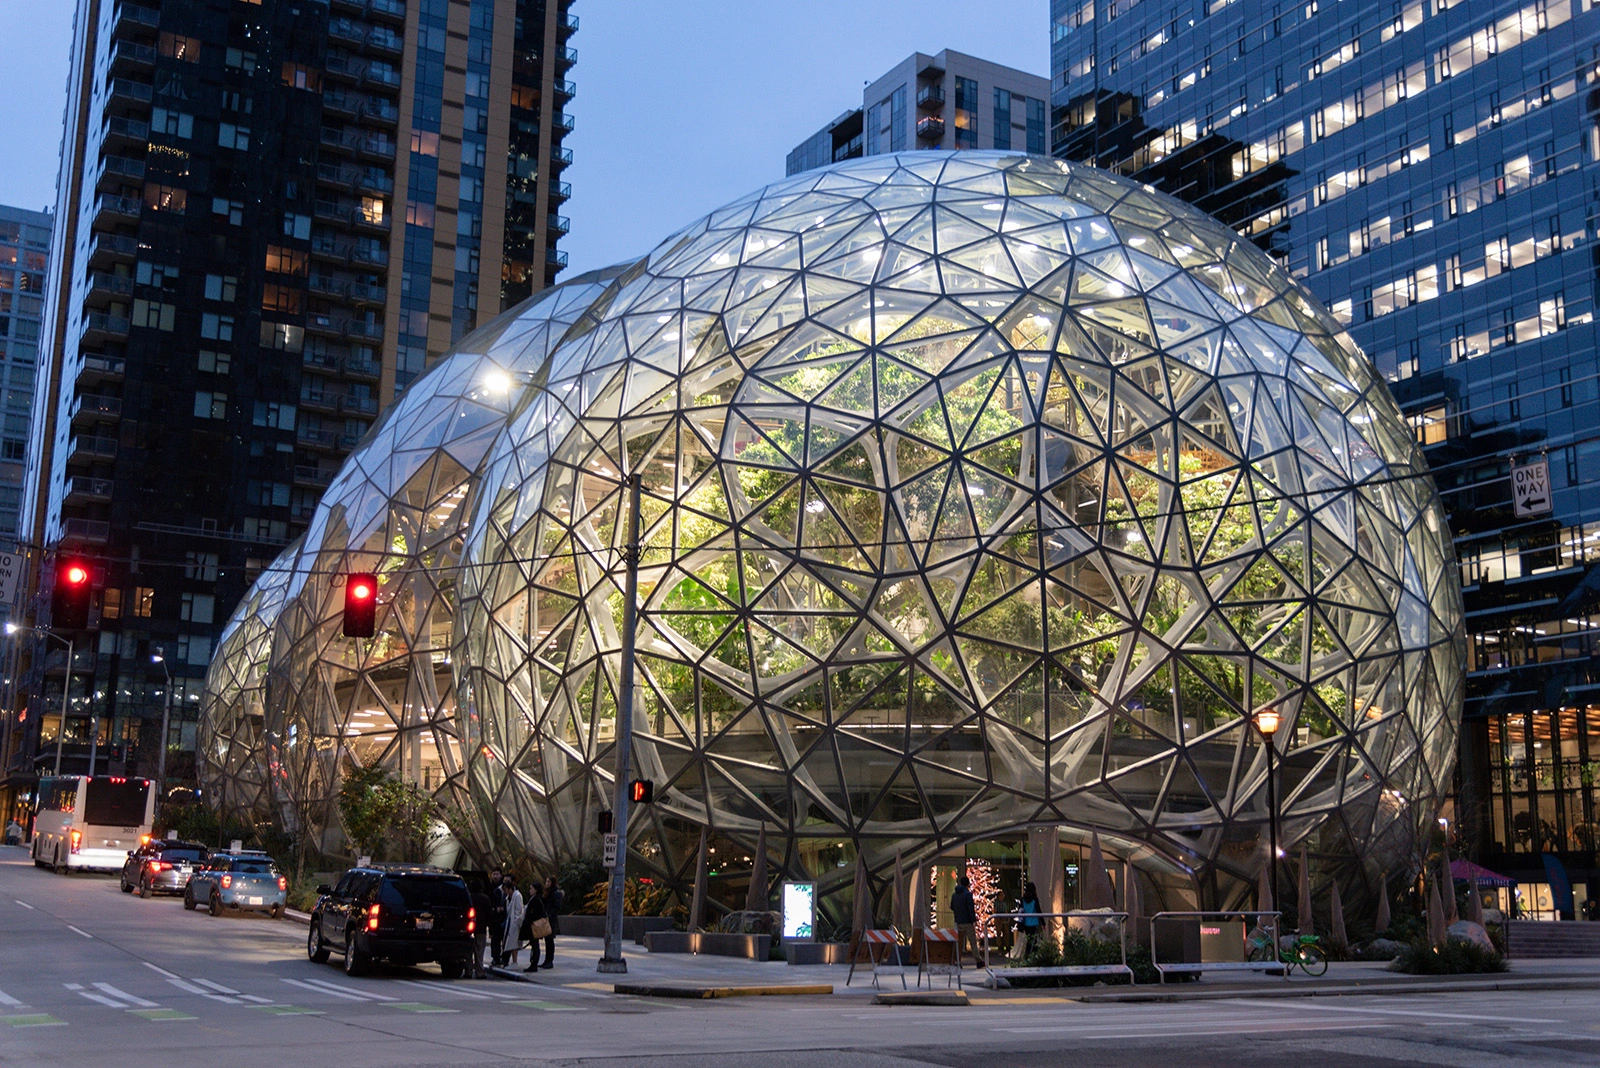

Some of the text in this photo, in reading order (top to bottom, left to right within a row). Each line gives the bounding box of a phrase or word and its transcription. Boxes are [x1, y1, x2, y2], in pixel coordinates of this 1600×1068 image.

[1516, 466, 1543, 483] ONE
[1517, 480, 1545, 497] WAY
[0, 568, 12, 578] RN
[606, 836, 616, 845] ONE
[605, 845, 617, 853] WAY
